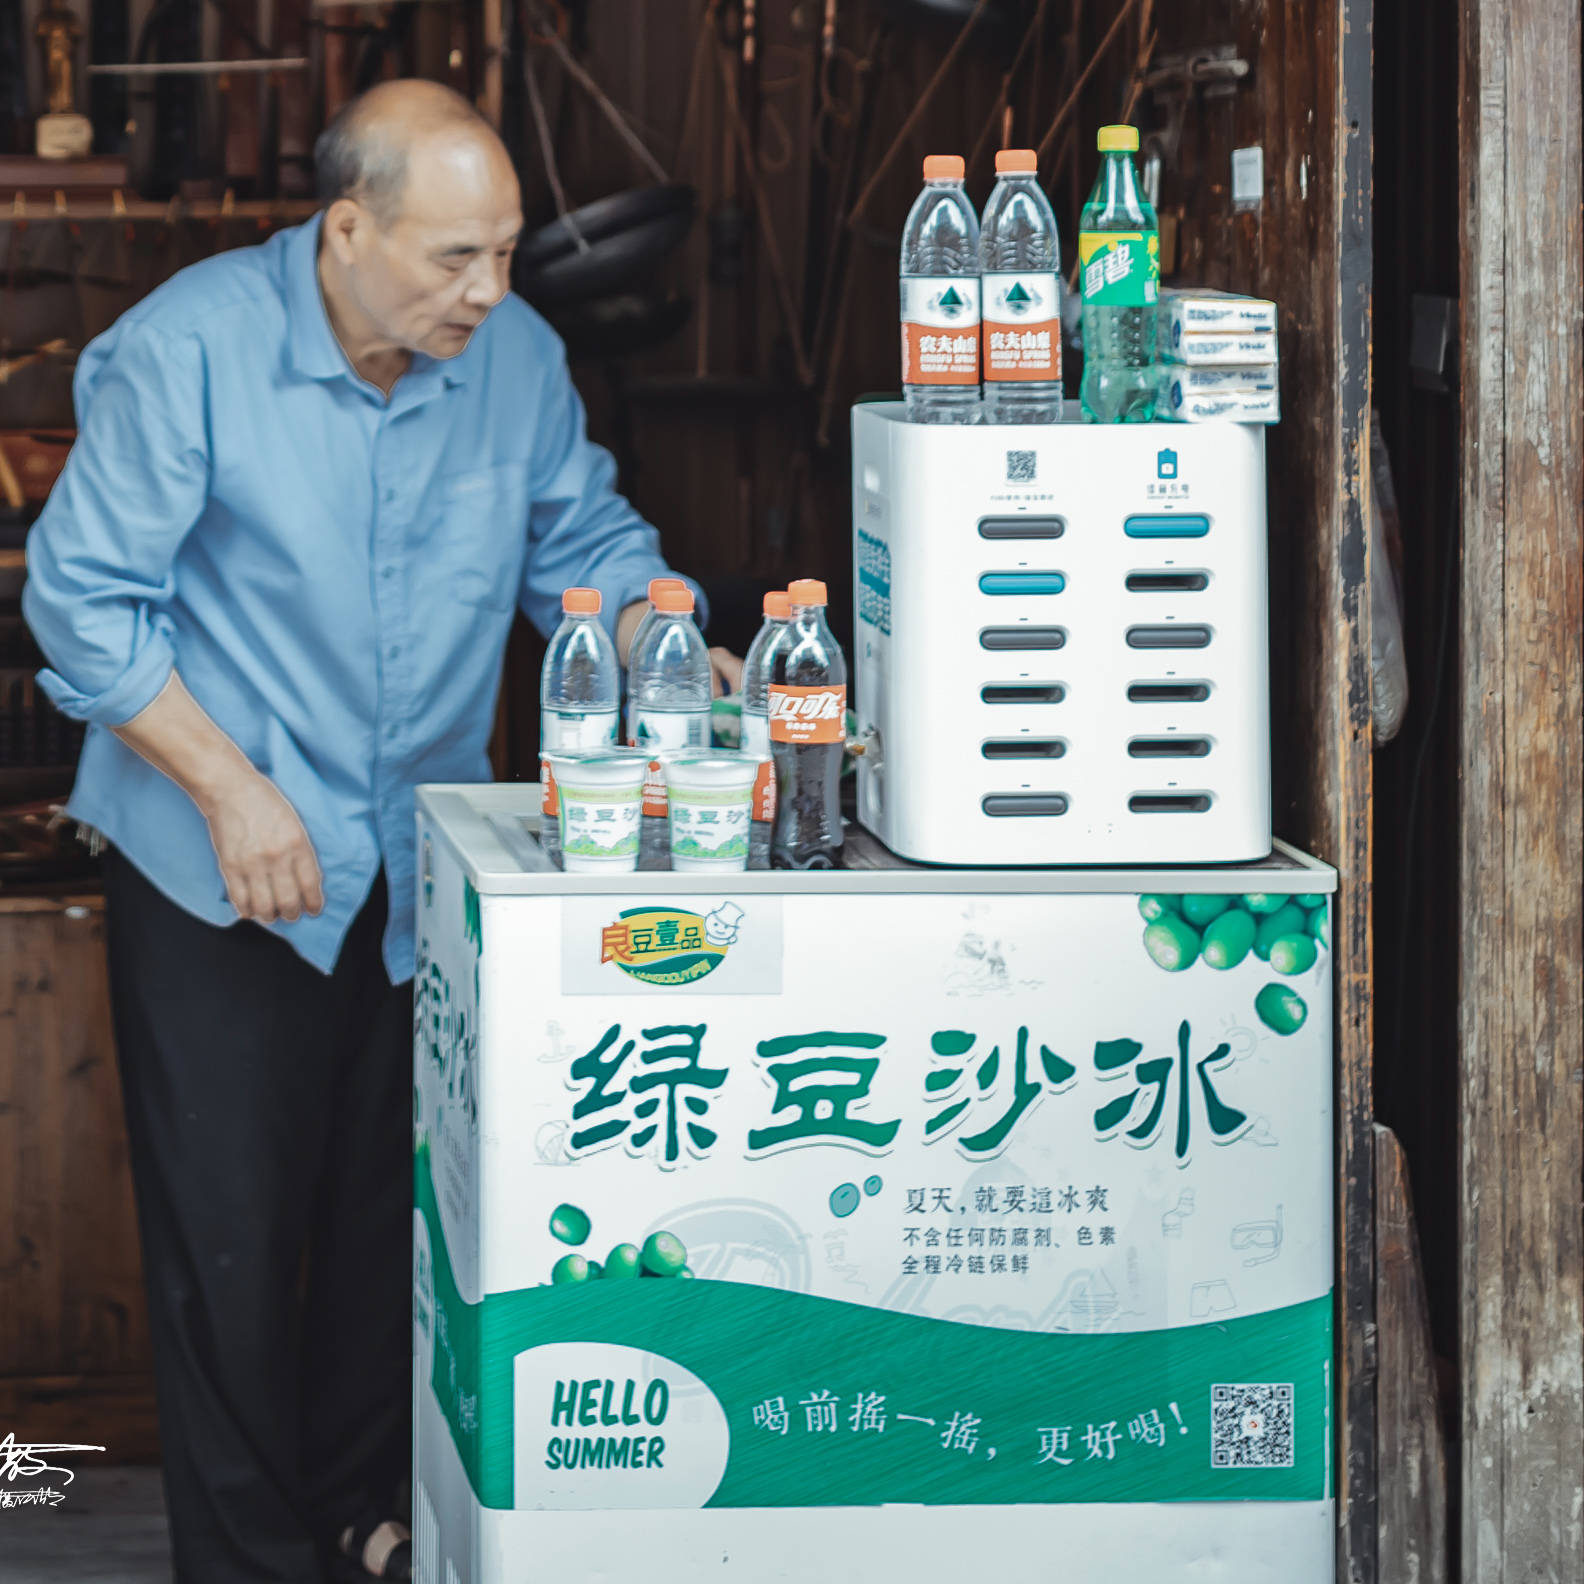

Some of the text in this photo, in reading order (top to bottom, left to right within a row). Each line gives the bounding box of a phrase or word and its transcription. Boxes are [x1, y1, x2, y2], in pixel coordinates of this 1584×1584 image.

[1084, 243, 1135, 300] 雪碧
[990, 330, 1051, 350] 农夫山泉
[600, 919, 703, 965] 良豆壹品
[570, 1019, 1248, 1163] 绿豆沙冰
[901, 1253, 1031, 1276] 全程冷链保鲜
[550, 1377, 670, 1428] HELLO
[544, 1435, 666, 1470] SUMMER
